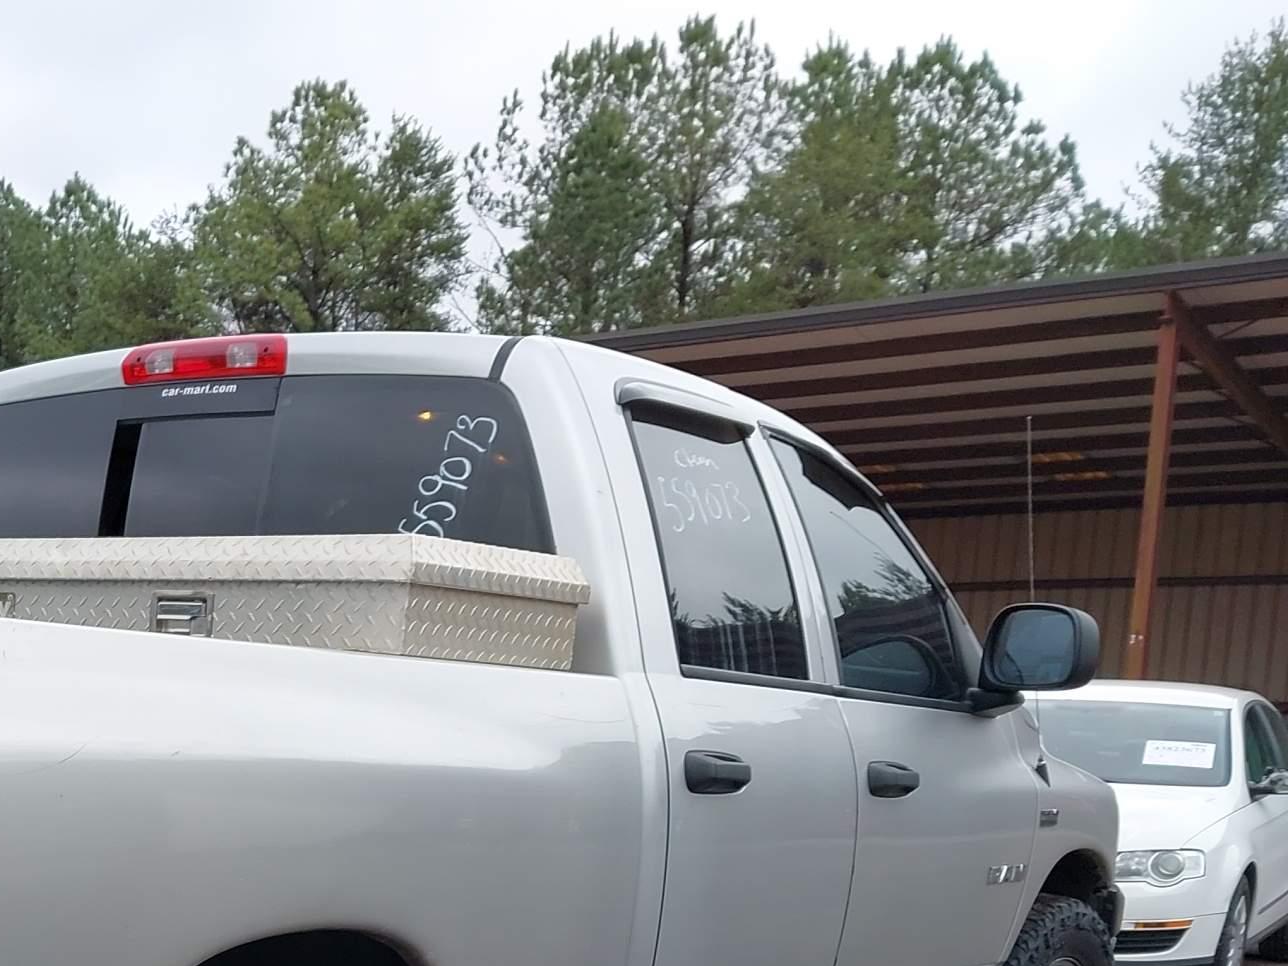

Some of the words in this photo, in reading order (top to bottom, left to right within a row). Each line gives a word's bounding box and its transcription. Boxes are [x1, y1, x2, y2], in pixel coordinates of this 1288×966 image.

[161, 384, 238, 398] car-mart.com
[398, 414, 498, 538] 559073
[656, 475, 752, 532] 559073
